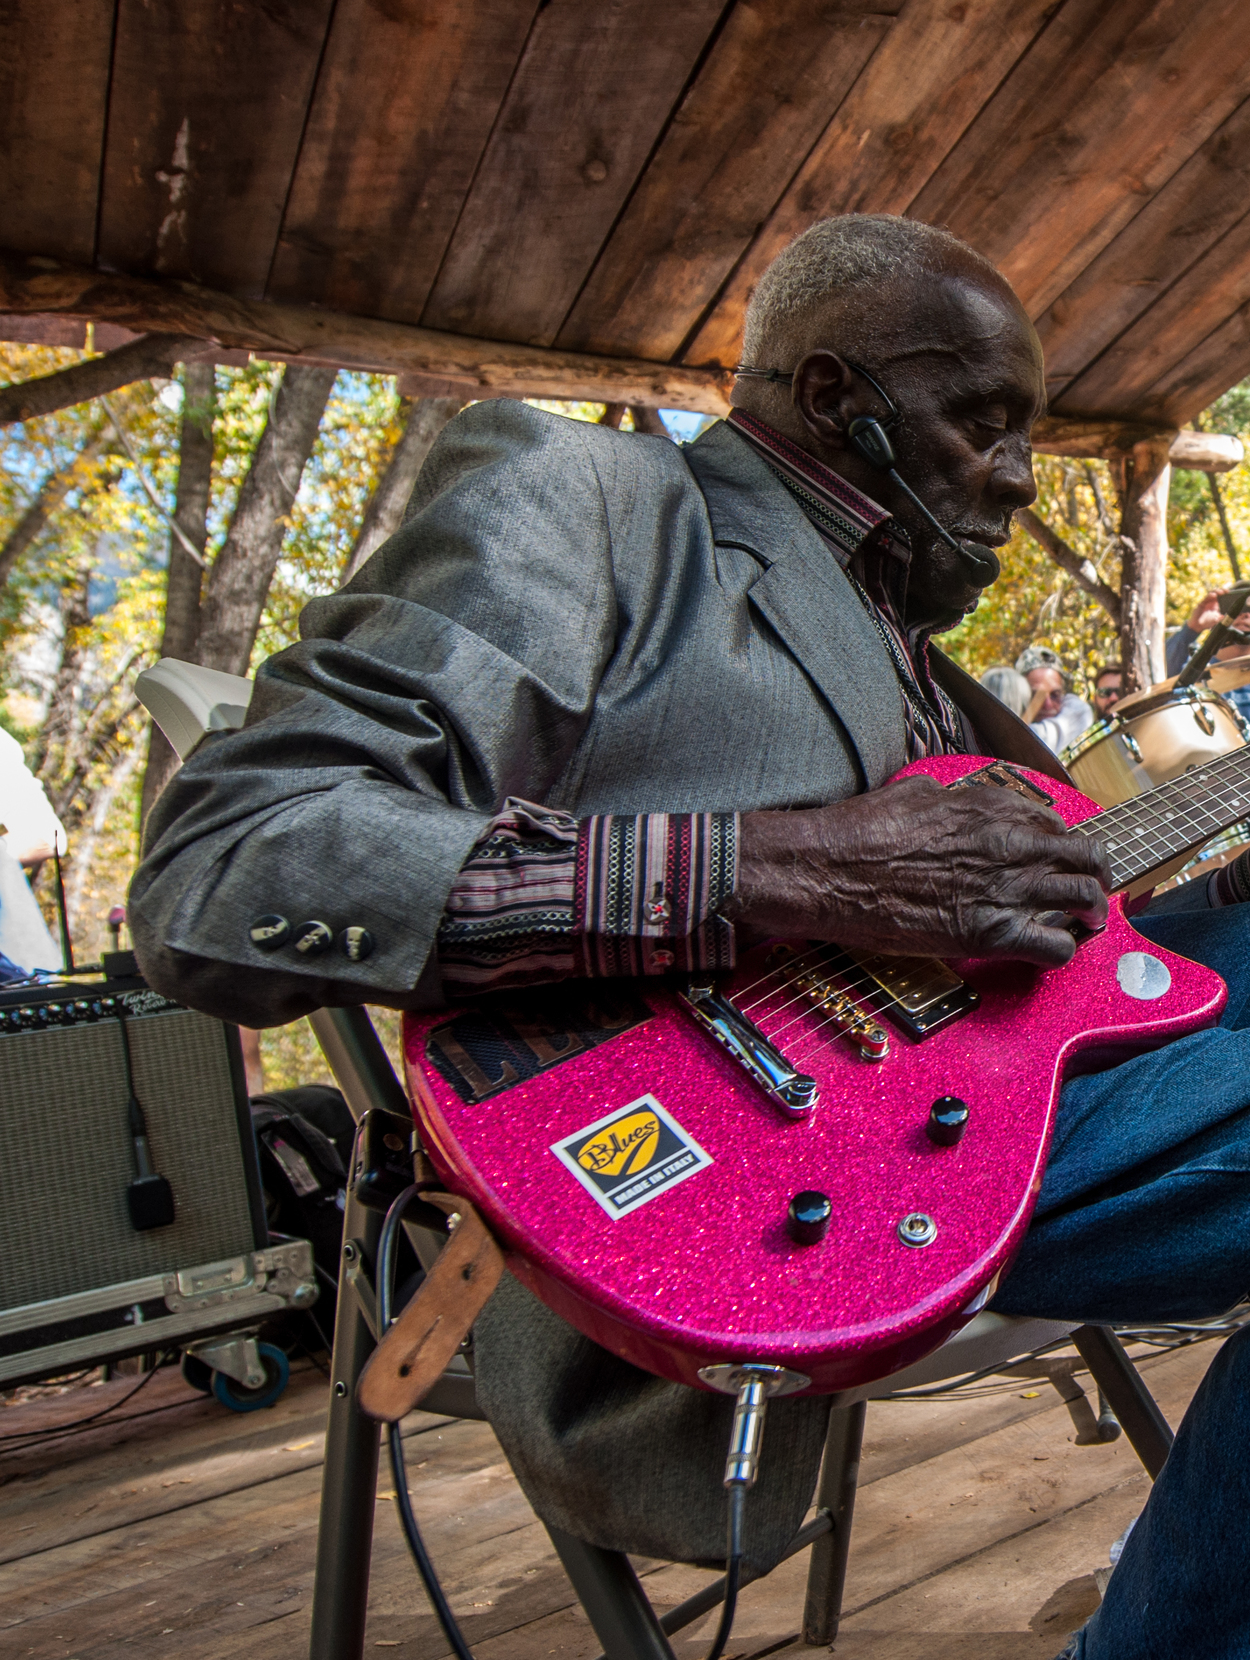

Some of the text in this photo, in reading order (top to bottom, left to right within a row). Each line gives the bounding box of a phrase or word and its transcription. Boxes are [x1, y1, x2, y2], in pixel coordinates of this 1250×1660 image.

[116, 990, 160, 1007] Twin
[578, 1120, 660, 1172] Blues
[613, 1154, 695, 1205] MADE IN ITALY
